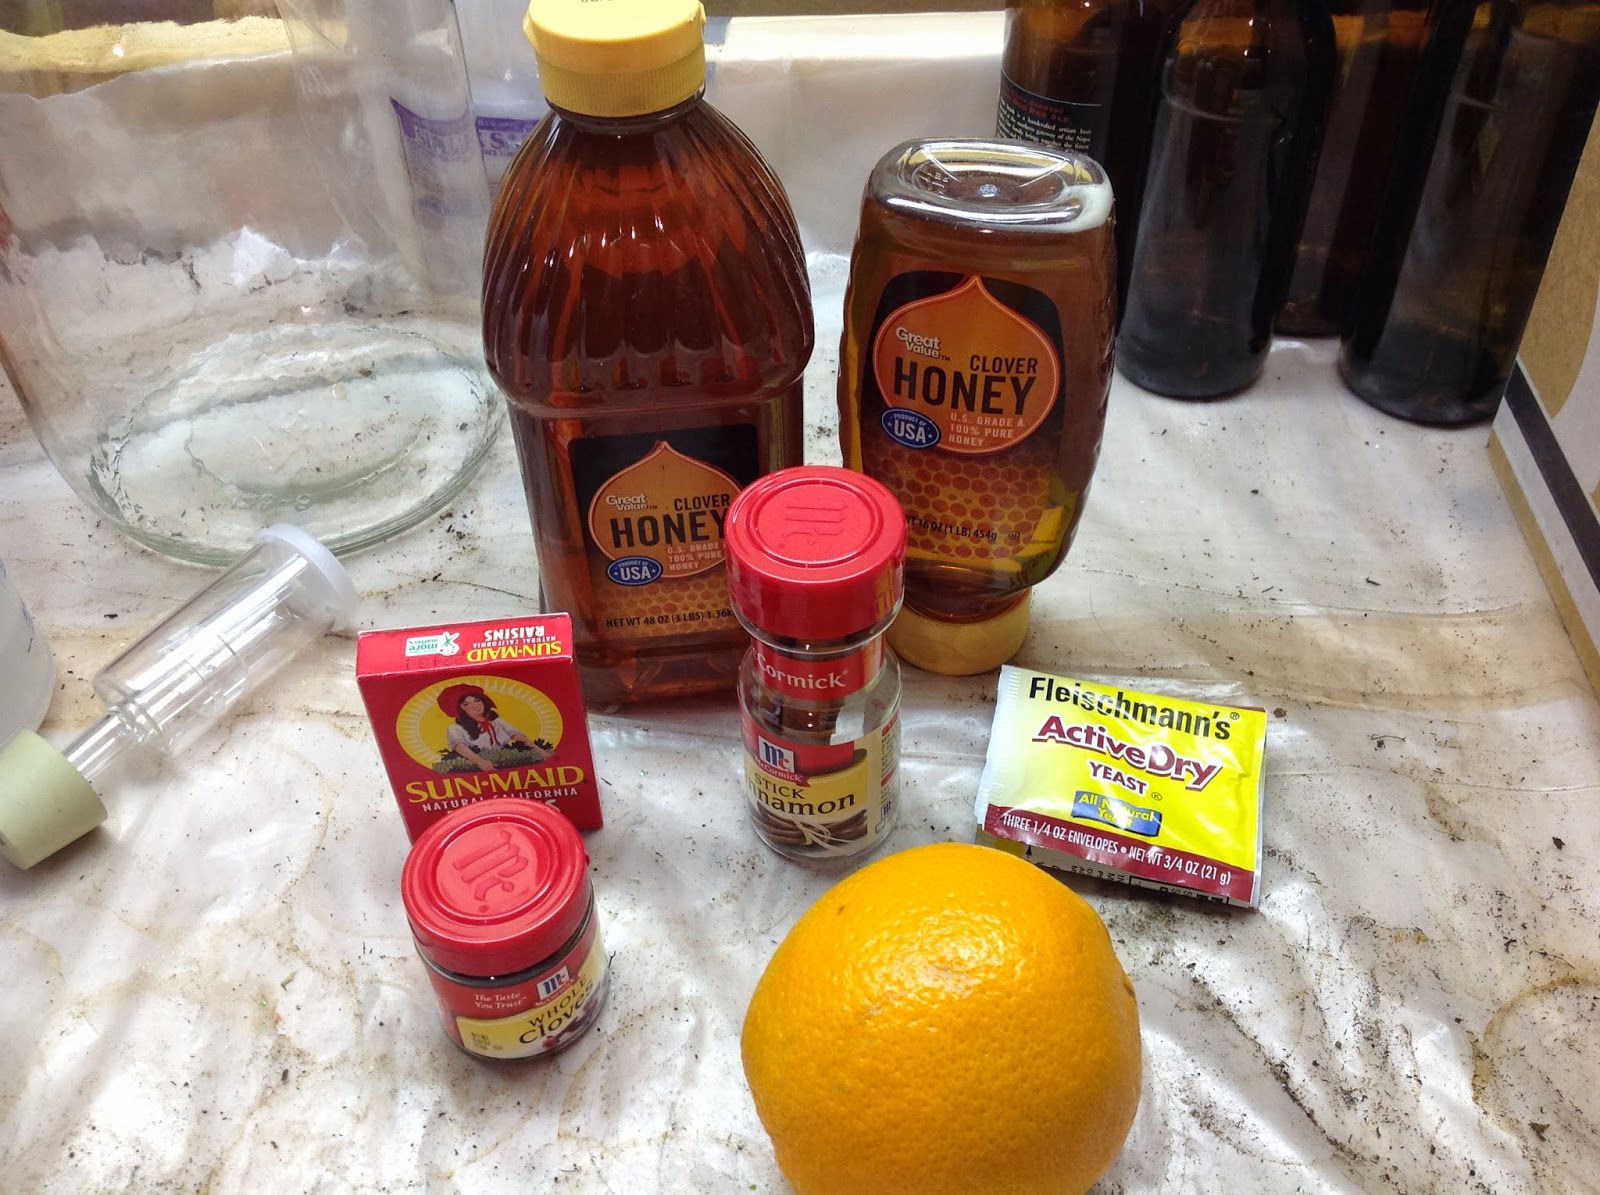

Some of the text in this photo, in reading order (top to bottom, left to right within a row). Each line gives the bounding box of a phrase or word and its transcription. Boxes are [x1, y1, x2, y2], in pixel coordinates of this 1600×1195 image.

[1057, 133, 1064, 141] of
[1065, 134, 1074, 142] the
[1058, 126, 1077, 134] artisan
[1079, 127, 1093, 136] beer
[895, 326, 941, 350] Great
[905, 341, 940, 358] Value
[969, 354, 1038, 374] CLOVER
[893, 356, 1037, 415] HONEY
[893, 413, 919, 425] PRODUCT
[950, 412, 1025, 428] U.S. GRADE A
[893, 419, 927, 444] USA
[949, 423, 1014, 439] 100% PURE
[948, 433, 984, 447] HONEY
[606, 493, 648, 505] Great
[616, 503, 648, 511] Value
[673, 493, 730, 511] CLOVER
[609, 508, 726, 549] HONEY
[918, 518, 930, 530] 16
[931, 520, 943, 533] OZ
[944, 524, 954, 536] (1
[956, 526, 972, 538] LB)
[972, 529, 998, 542] 454g
[667, 545, 686, 554] U.S.
[689, 542, 720, 552] GRADE
[669, 550, 722, 563] 100% PURE
[620, 566, 651, 581] USA
[669, 562, 699, 572] HONEY
[606, 618, 624, 628] NET
[625, 617, 644, 626] WT
[644, 616, 656, 625] 48
[657, 615, 671, 625] OZ
[671, 613, 681, 624] (3
[683, 611, 705, 622] LBS)
[484, 625, 545, 642] RAISINS
[408, 643, 438, 651] more
[472, 635, 556, 649] NATURAL CALIFORNIA
[1029, 676, 1231, 740] Fleischmann's
[755, 756, 804, 783] McCormick
[754, 773, 805, 799] STICK
[1089, 761, 1147, 795] YEAST
[1078, 793, 1098, 805] All
[1002, 813, 1030, 832] THREE
[1033, 818, 1050, 836] 1/4
[1053, 825, 1067, 841] OZ
[1067, 828, 1119, 854] ENVELOPES
[1129, 845, 1146, 862] NET
[1164, 855, 1183, 871] 3/4
[1185, 860, 1200, 876] OZ
[1201, 864, 1217, 880] (21
[1219, 871, 1231, 885] g)
[473, 991, 522, 1002] The Taste
[475, 999, 523, 1010] You Trust
[529, 974, 587, 1027] WHOLE
[518, 981, 593, 1044] Cloves
